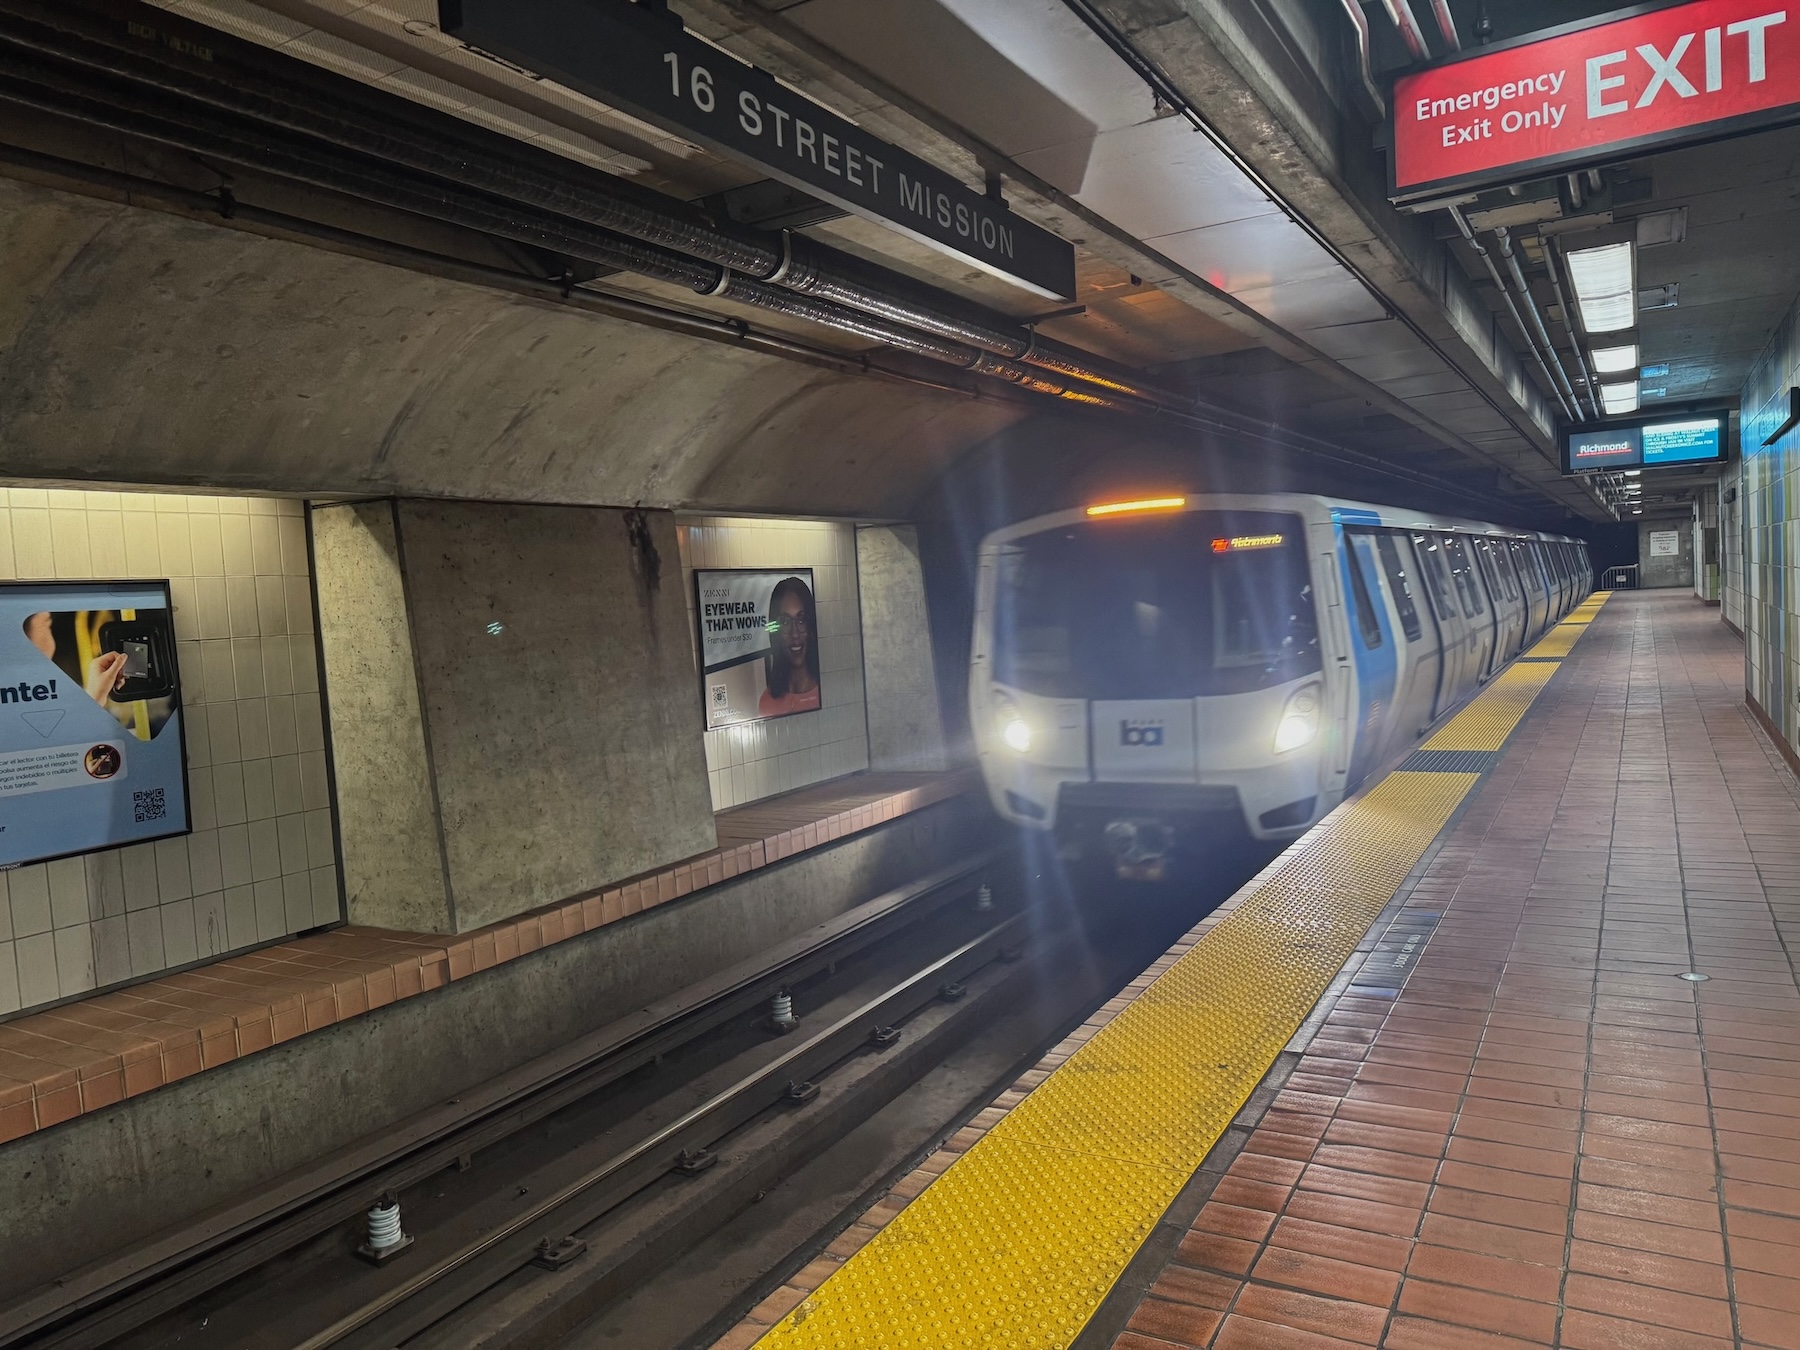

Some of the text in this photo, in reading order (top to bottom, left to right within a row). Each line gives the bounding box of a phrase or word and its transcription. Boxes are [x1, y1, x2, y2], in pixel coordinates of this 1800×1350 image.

[1585, 10, 1787, 119] EXIT
[1415, 69, 1567, 121] Emergency
[1441, 102, 1567, 148] Exit Only
[663, 52, 1014, 259] 16 STREET MISSION
[1580, 441, 1628, 453] Richmond
[705, 601, 755, 616] EYEWEAR
[706, 615, 767, 632] THAT WOWS
[742, 632, 753, 642] $30
[0, 679, 58, 704] nte!
[16, 764, 43, 772] aumenta
[17, 756, 35, 764] lector
